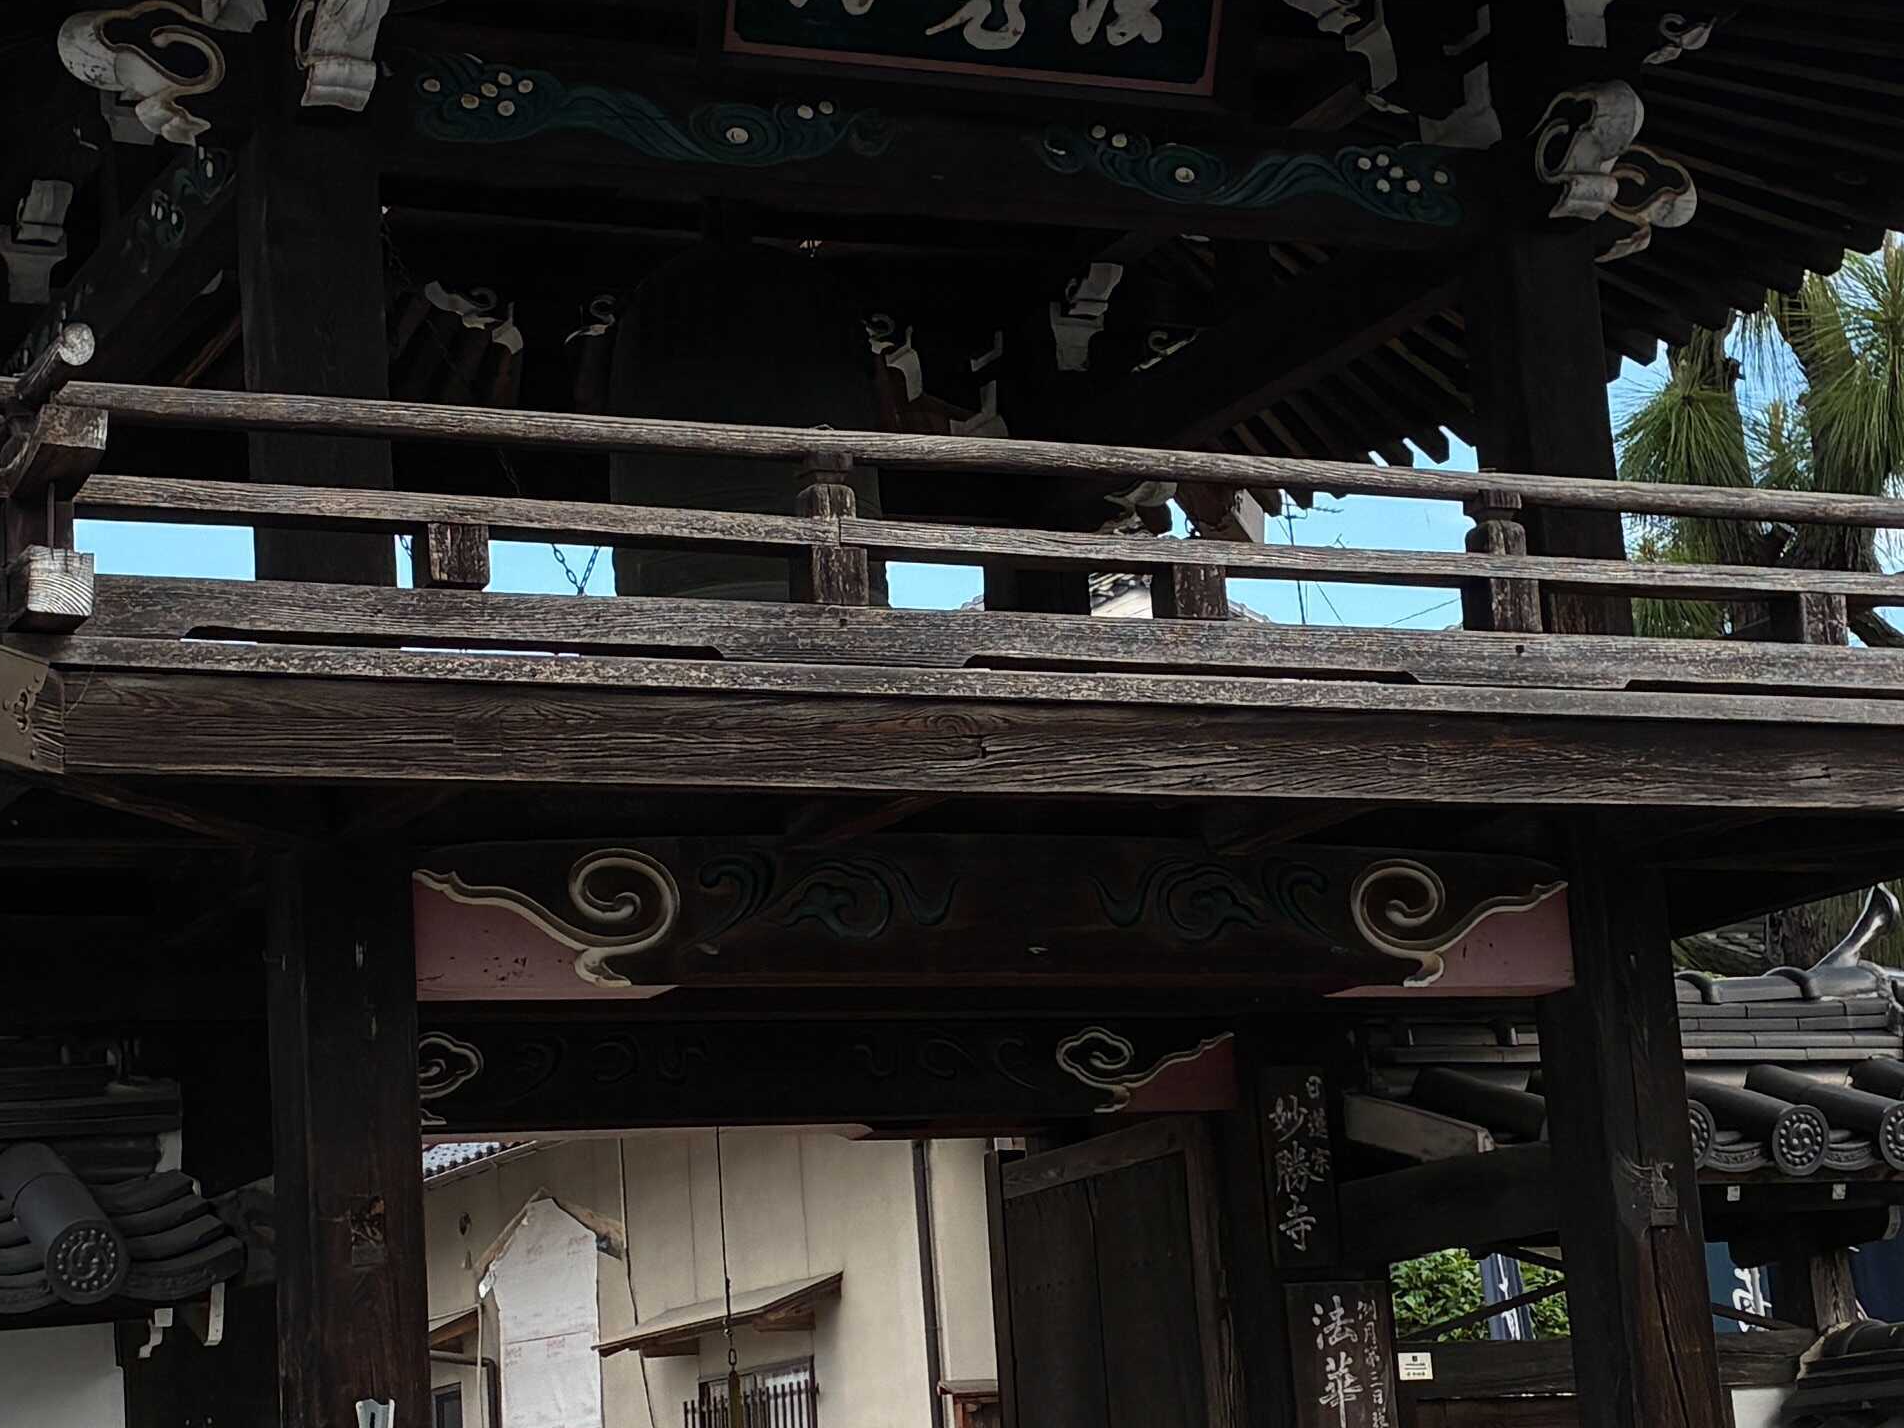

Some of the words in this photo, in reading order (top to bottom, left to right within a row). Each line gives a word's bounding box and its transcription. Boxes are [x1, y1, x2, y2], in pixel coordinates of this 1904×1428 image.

[1267, 1093, 1326, 1252] 妙勝寺
[1304, 1075, 1332, 1175] 日蓮宗
